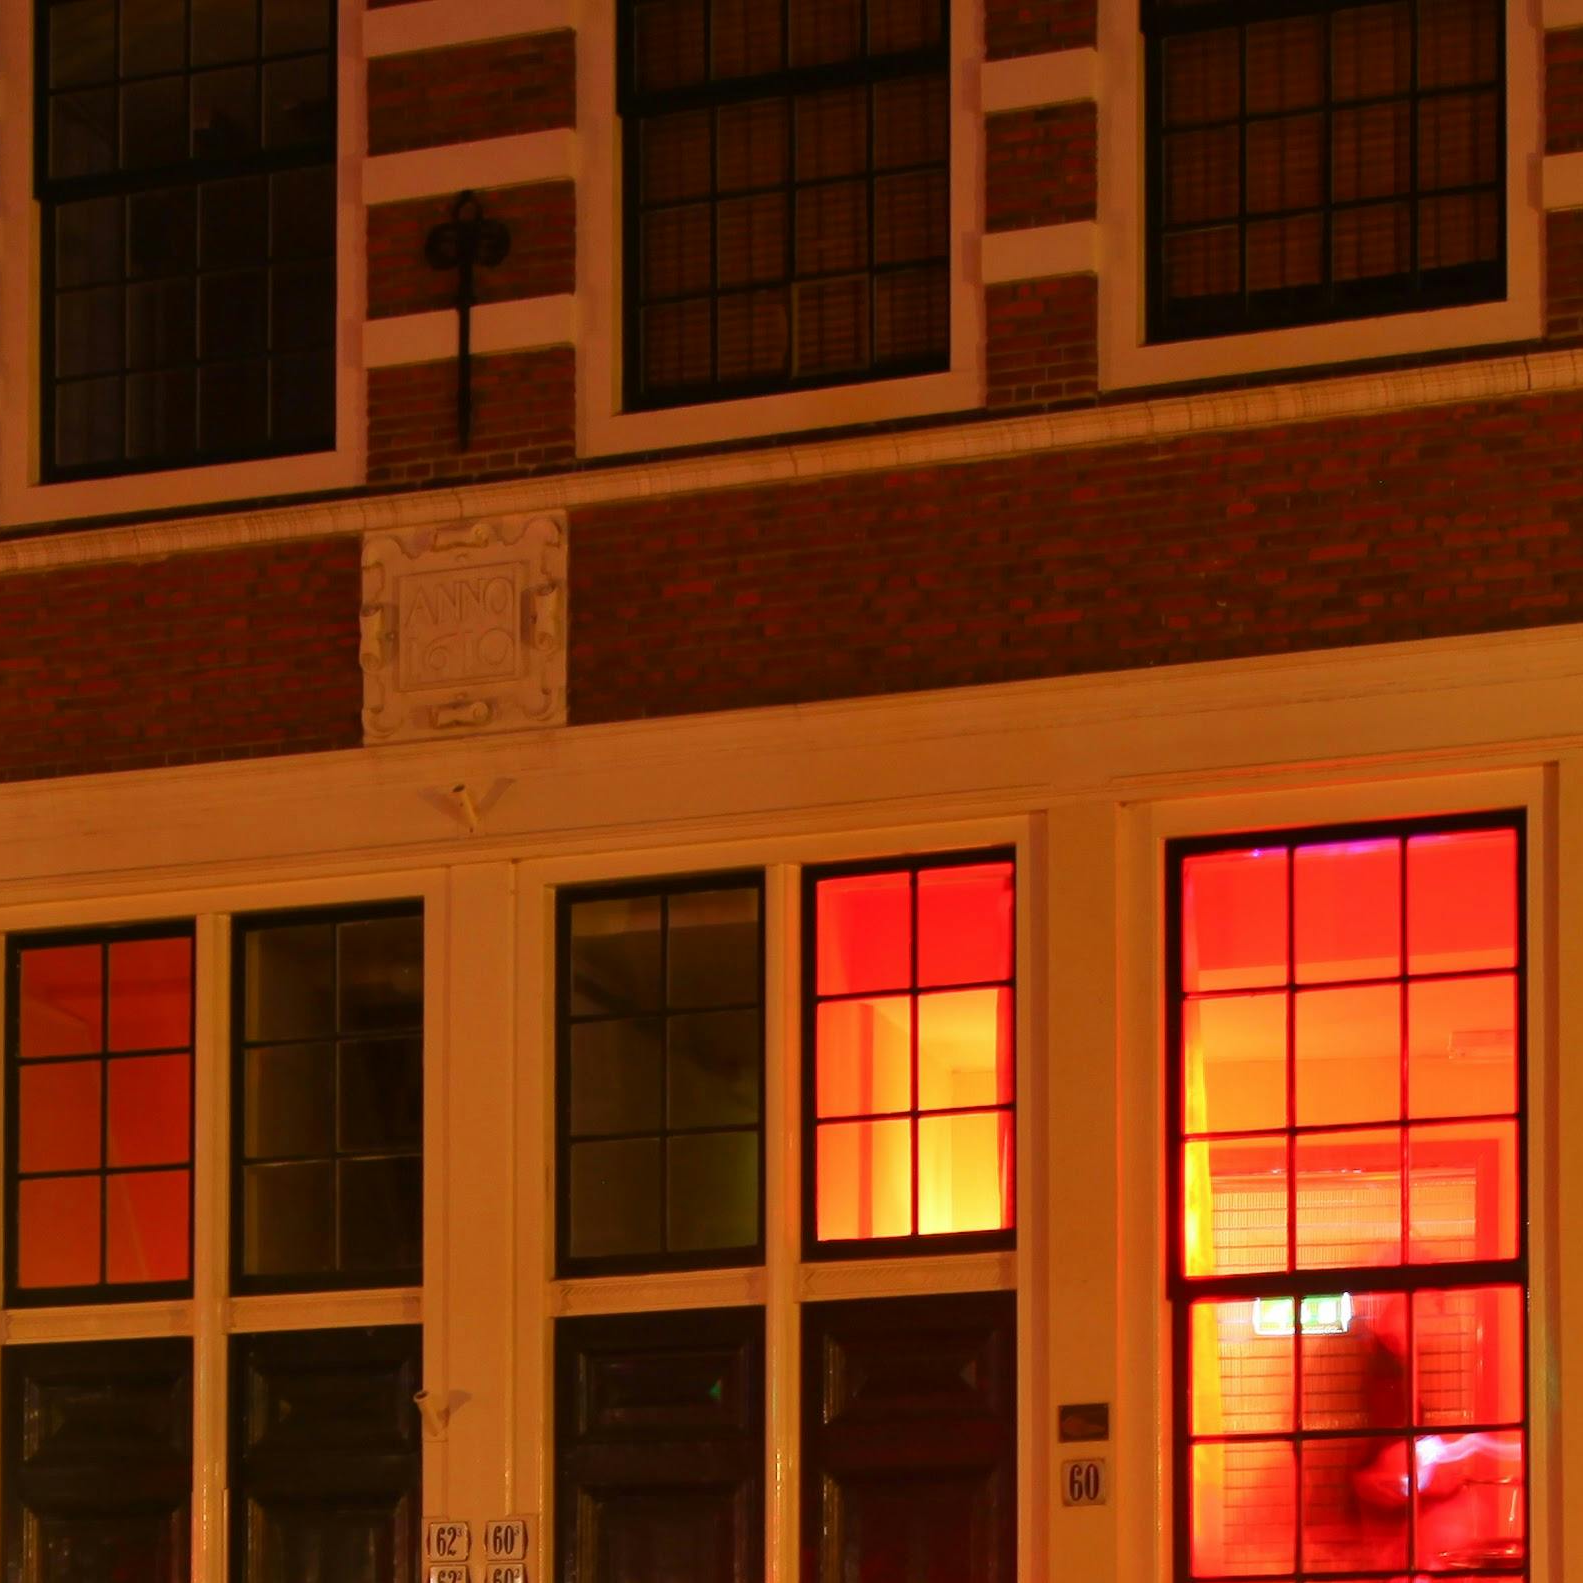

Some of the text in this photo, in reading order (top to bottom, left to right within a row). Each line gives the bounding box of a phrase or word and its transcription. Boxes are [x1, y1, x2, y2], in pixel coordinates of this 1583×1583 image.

[404, 577, 514, 626] ANNO
[406, 627, 514, 679] 1610
[1069, 1463, 1099, 1501] 60
